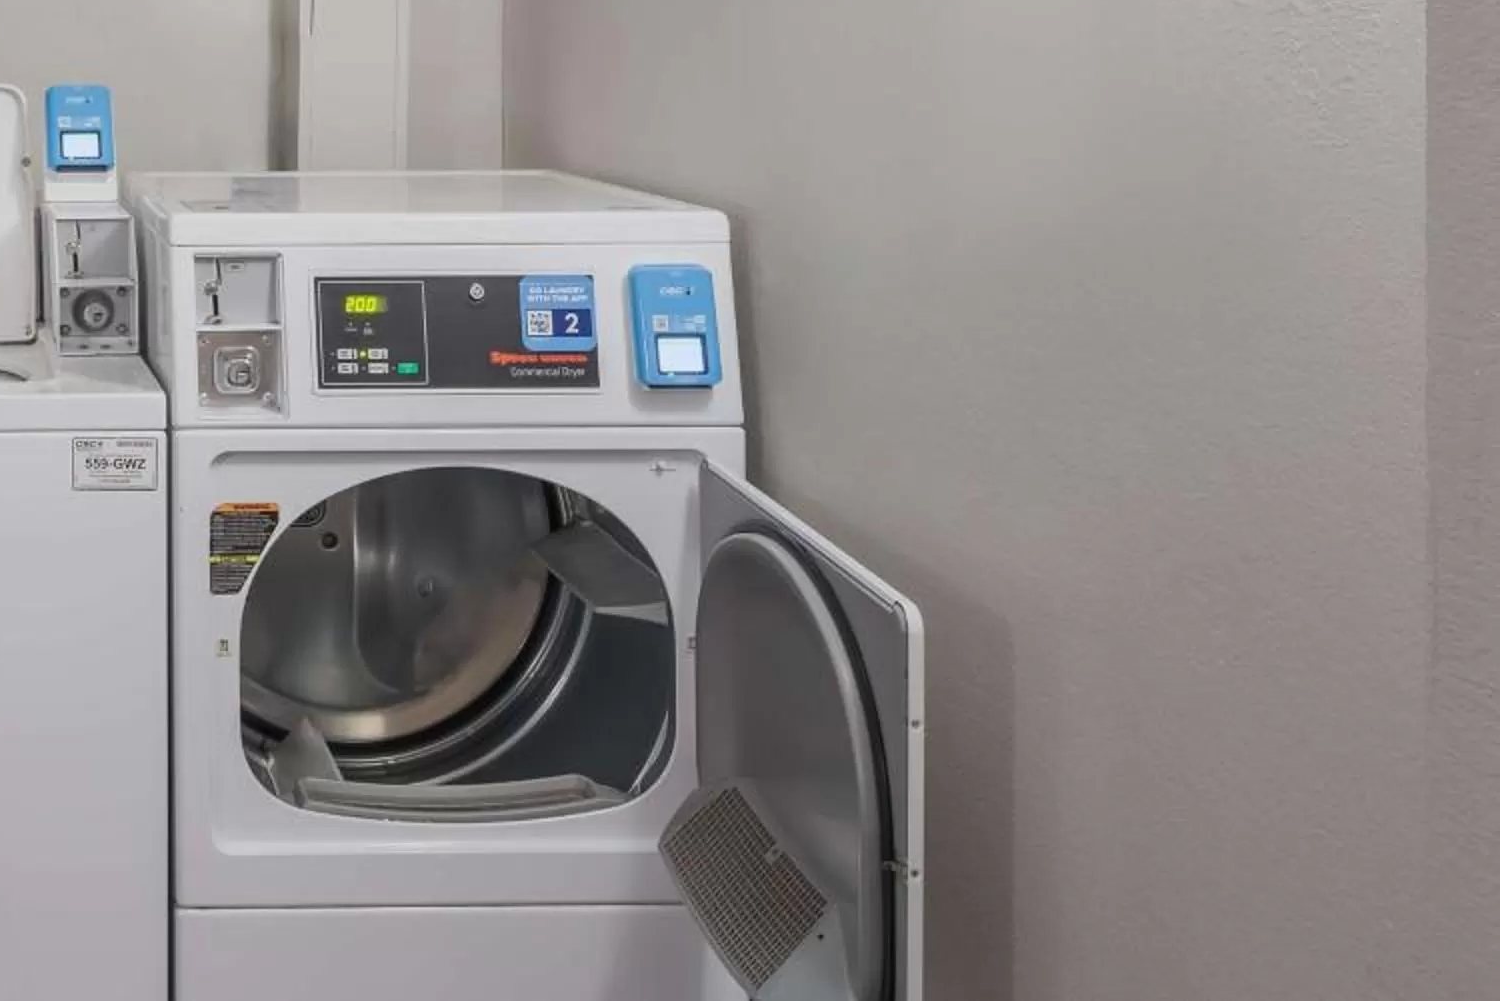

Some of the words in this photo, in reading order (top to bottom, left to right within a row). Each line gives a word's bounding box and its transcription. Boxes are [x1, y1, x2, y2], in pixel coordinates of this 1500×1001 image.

[527, 294, 550, 303] WITH
[551, 294, 569, 303] THE
[571, 294, 589, 303] APP
[564, 312, 580, 334] 2
[561, 366, 586, 378] Dryer
[84, 457, 147, 470] 559-GWZ
